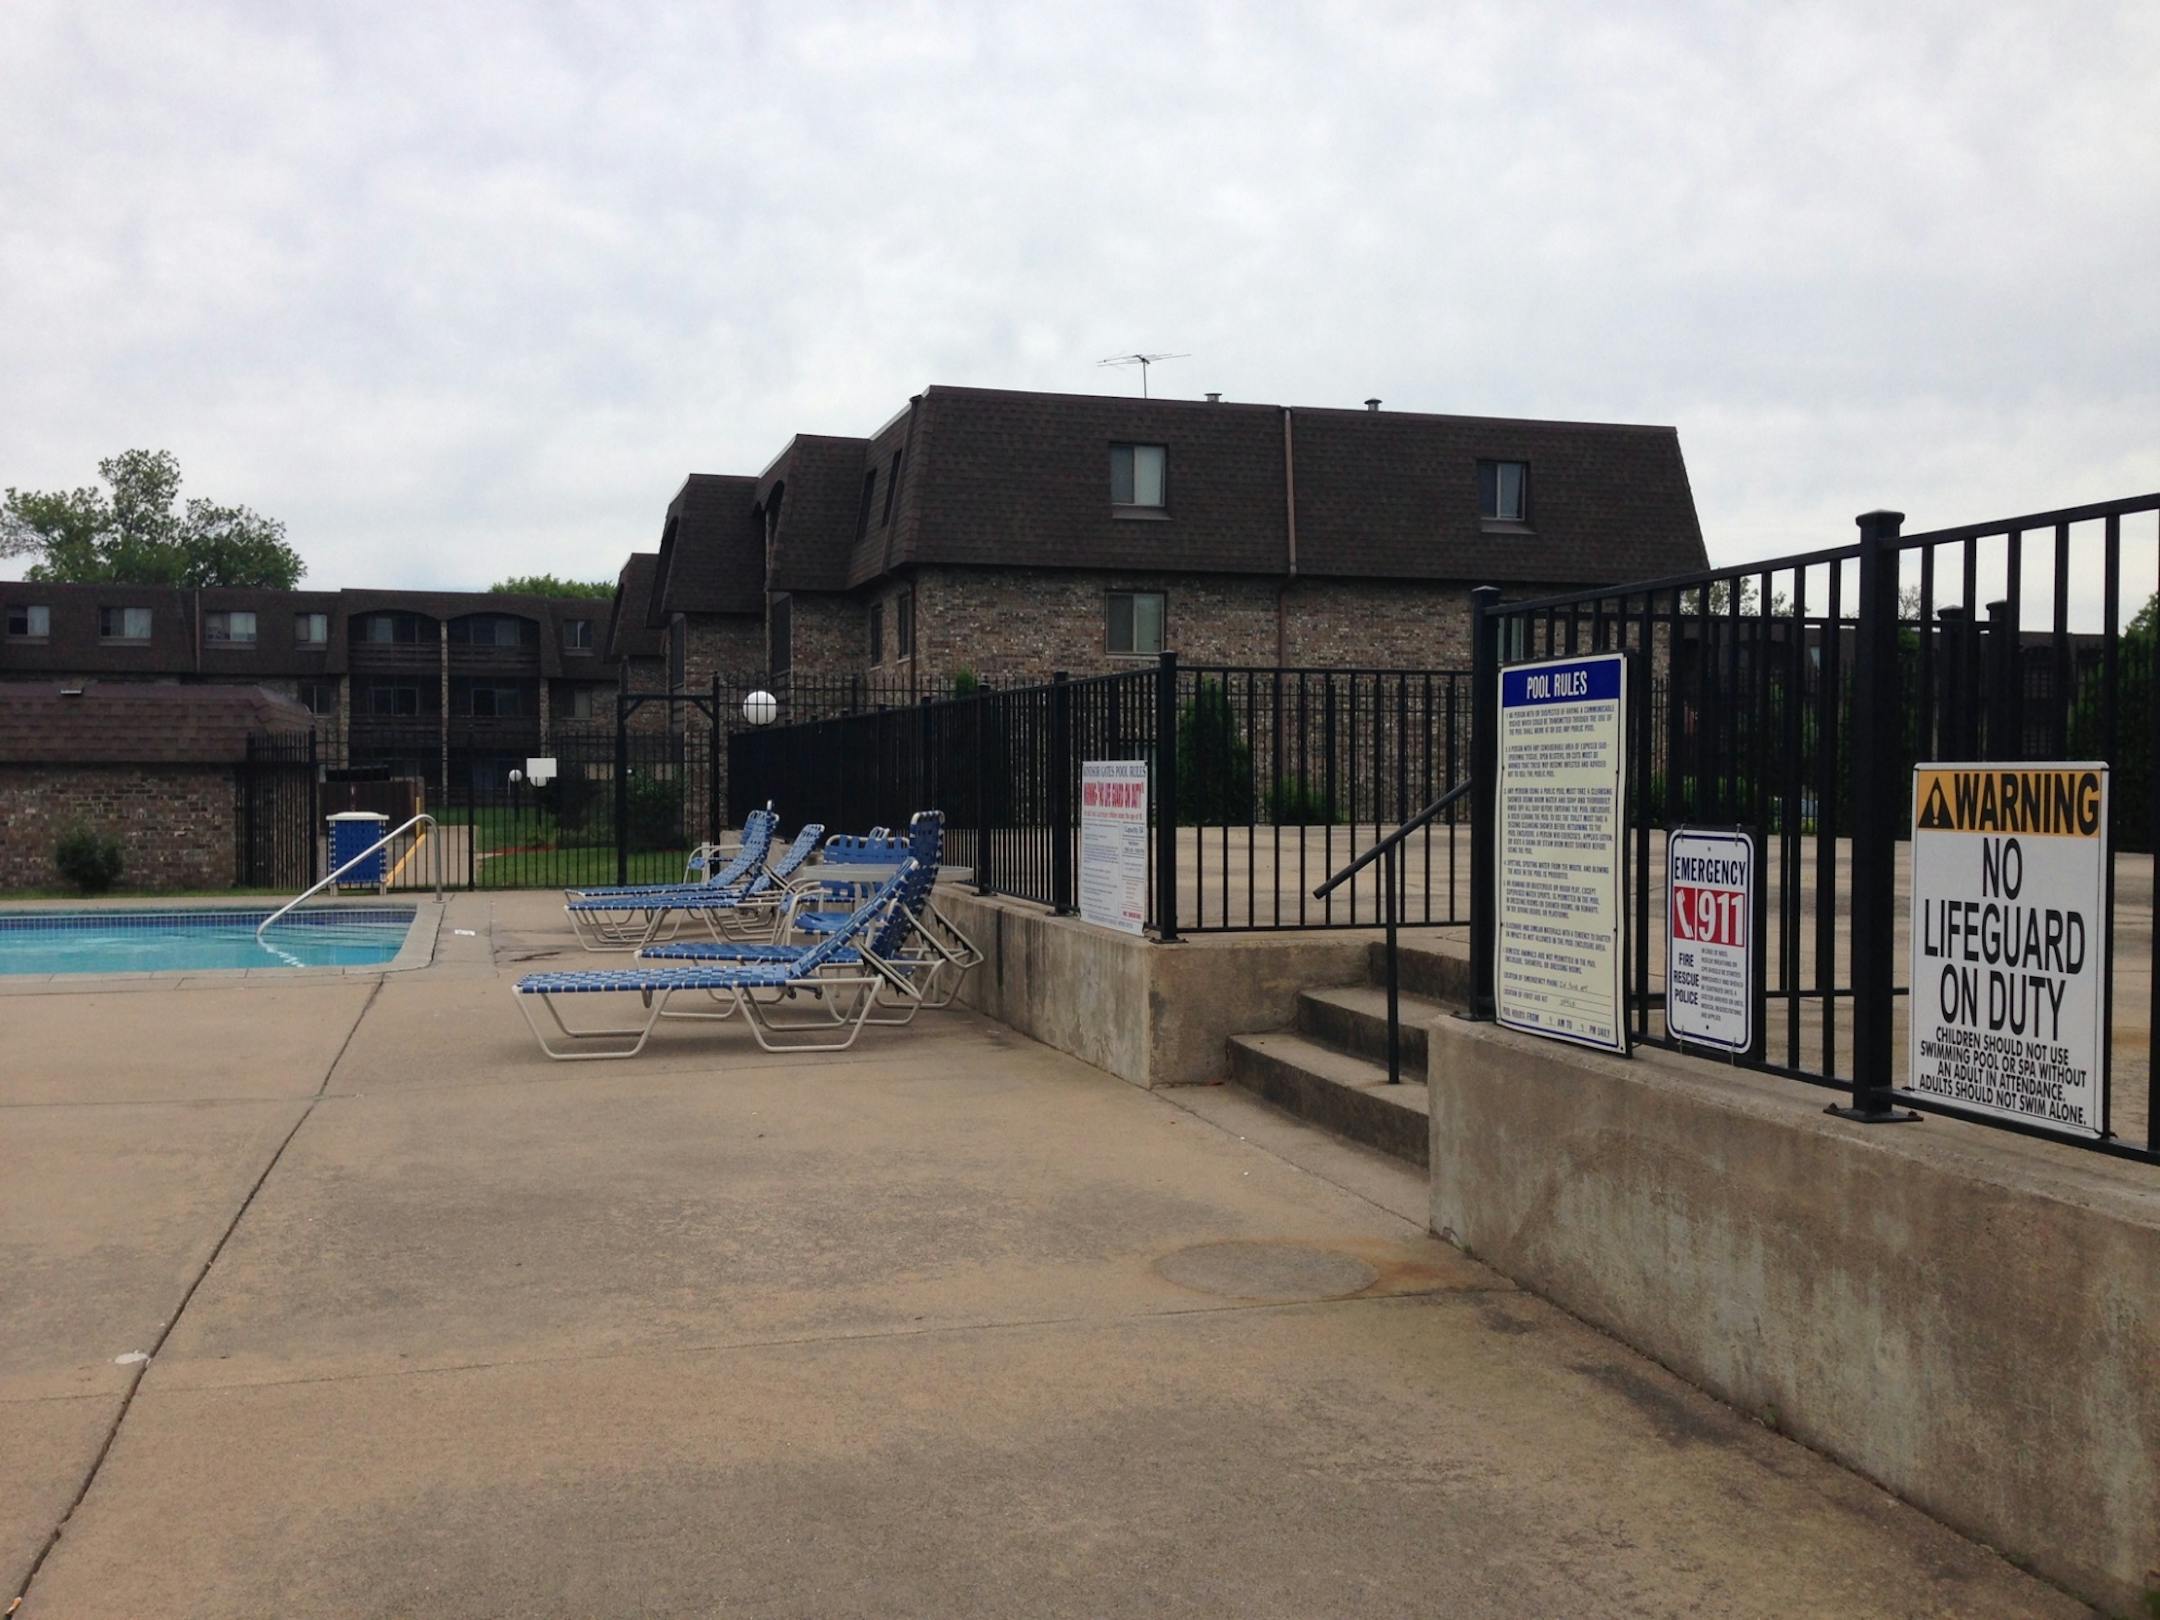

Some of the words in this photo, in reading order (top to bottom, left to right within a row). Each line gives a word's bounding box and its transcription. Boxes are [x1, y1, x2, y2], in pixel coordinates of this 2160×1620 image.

[1527, 674, 1551, 699] POOL
[1554, 671, 1587, 697] RULES
[1955, 773, 2098, 836] WARNING
[1675, 857, 1746, 886] EMERGENCY
[1983, 838, 2022, 900] NO
[1698, 890, 1744, 945] 911
[1924, 899, 2086, 974] LIFEGUARD
[1674, 971, 1699, 987] RESCUE
[1679, 953, 1694, 967] FIRE
[1675, 989, 1698, 1005] POLICE
[1940, 964, 1978, 1027] ON
[1990, 970, 2066, 1041] DUTY
[1920, 1040, 1970, 1064] SWIMMING
[1973, 1049, 1999, 1069] POOL
[2002, 1056, 2016, 1072] OR
[2019, 1059, 2036, 1076] SPA
[2039, 1063, 2086, 1088] WITHOUT
[1936, 1026, 1980, 1048] CHILDREN
[1984, 1034, 2023, 1056] SHOULD
[2026, 1043, 2048, 1061] NOT
[2050, 1048, 2069, 1066] USE
[1919, 1073, 1953, 1096] ADULTS
[1956, 1082, 1993, 1104] SHOULD
[1996, 1092, 2016, 1110] NOT
[2019, 1098, 2046, 1116] SWIM
[2048, 1106, 2087, 1125] ALONE.
[1937, 1060, 1951, 1078] AN
[1954, 1064, 1983, 1085] ADULT
[1986, 1072, 1996, 1087] IN
[1999, 1074, 2066, 1102] ATTENDANCE.
